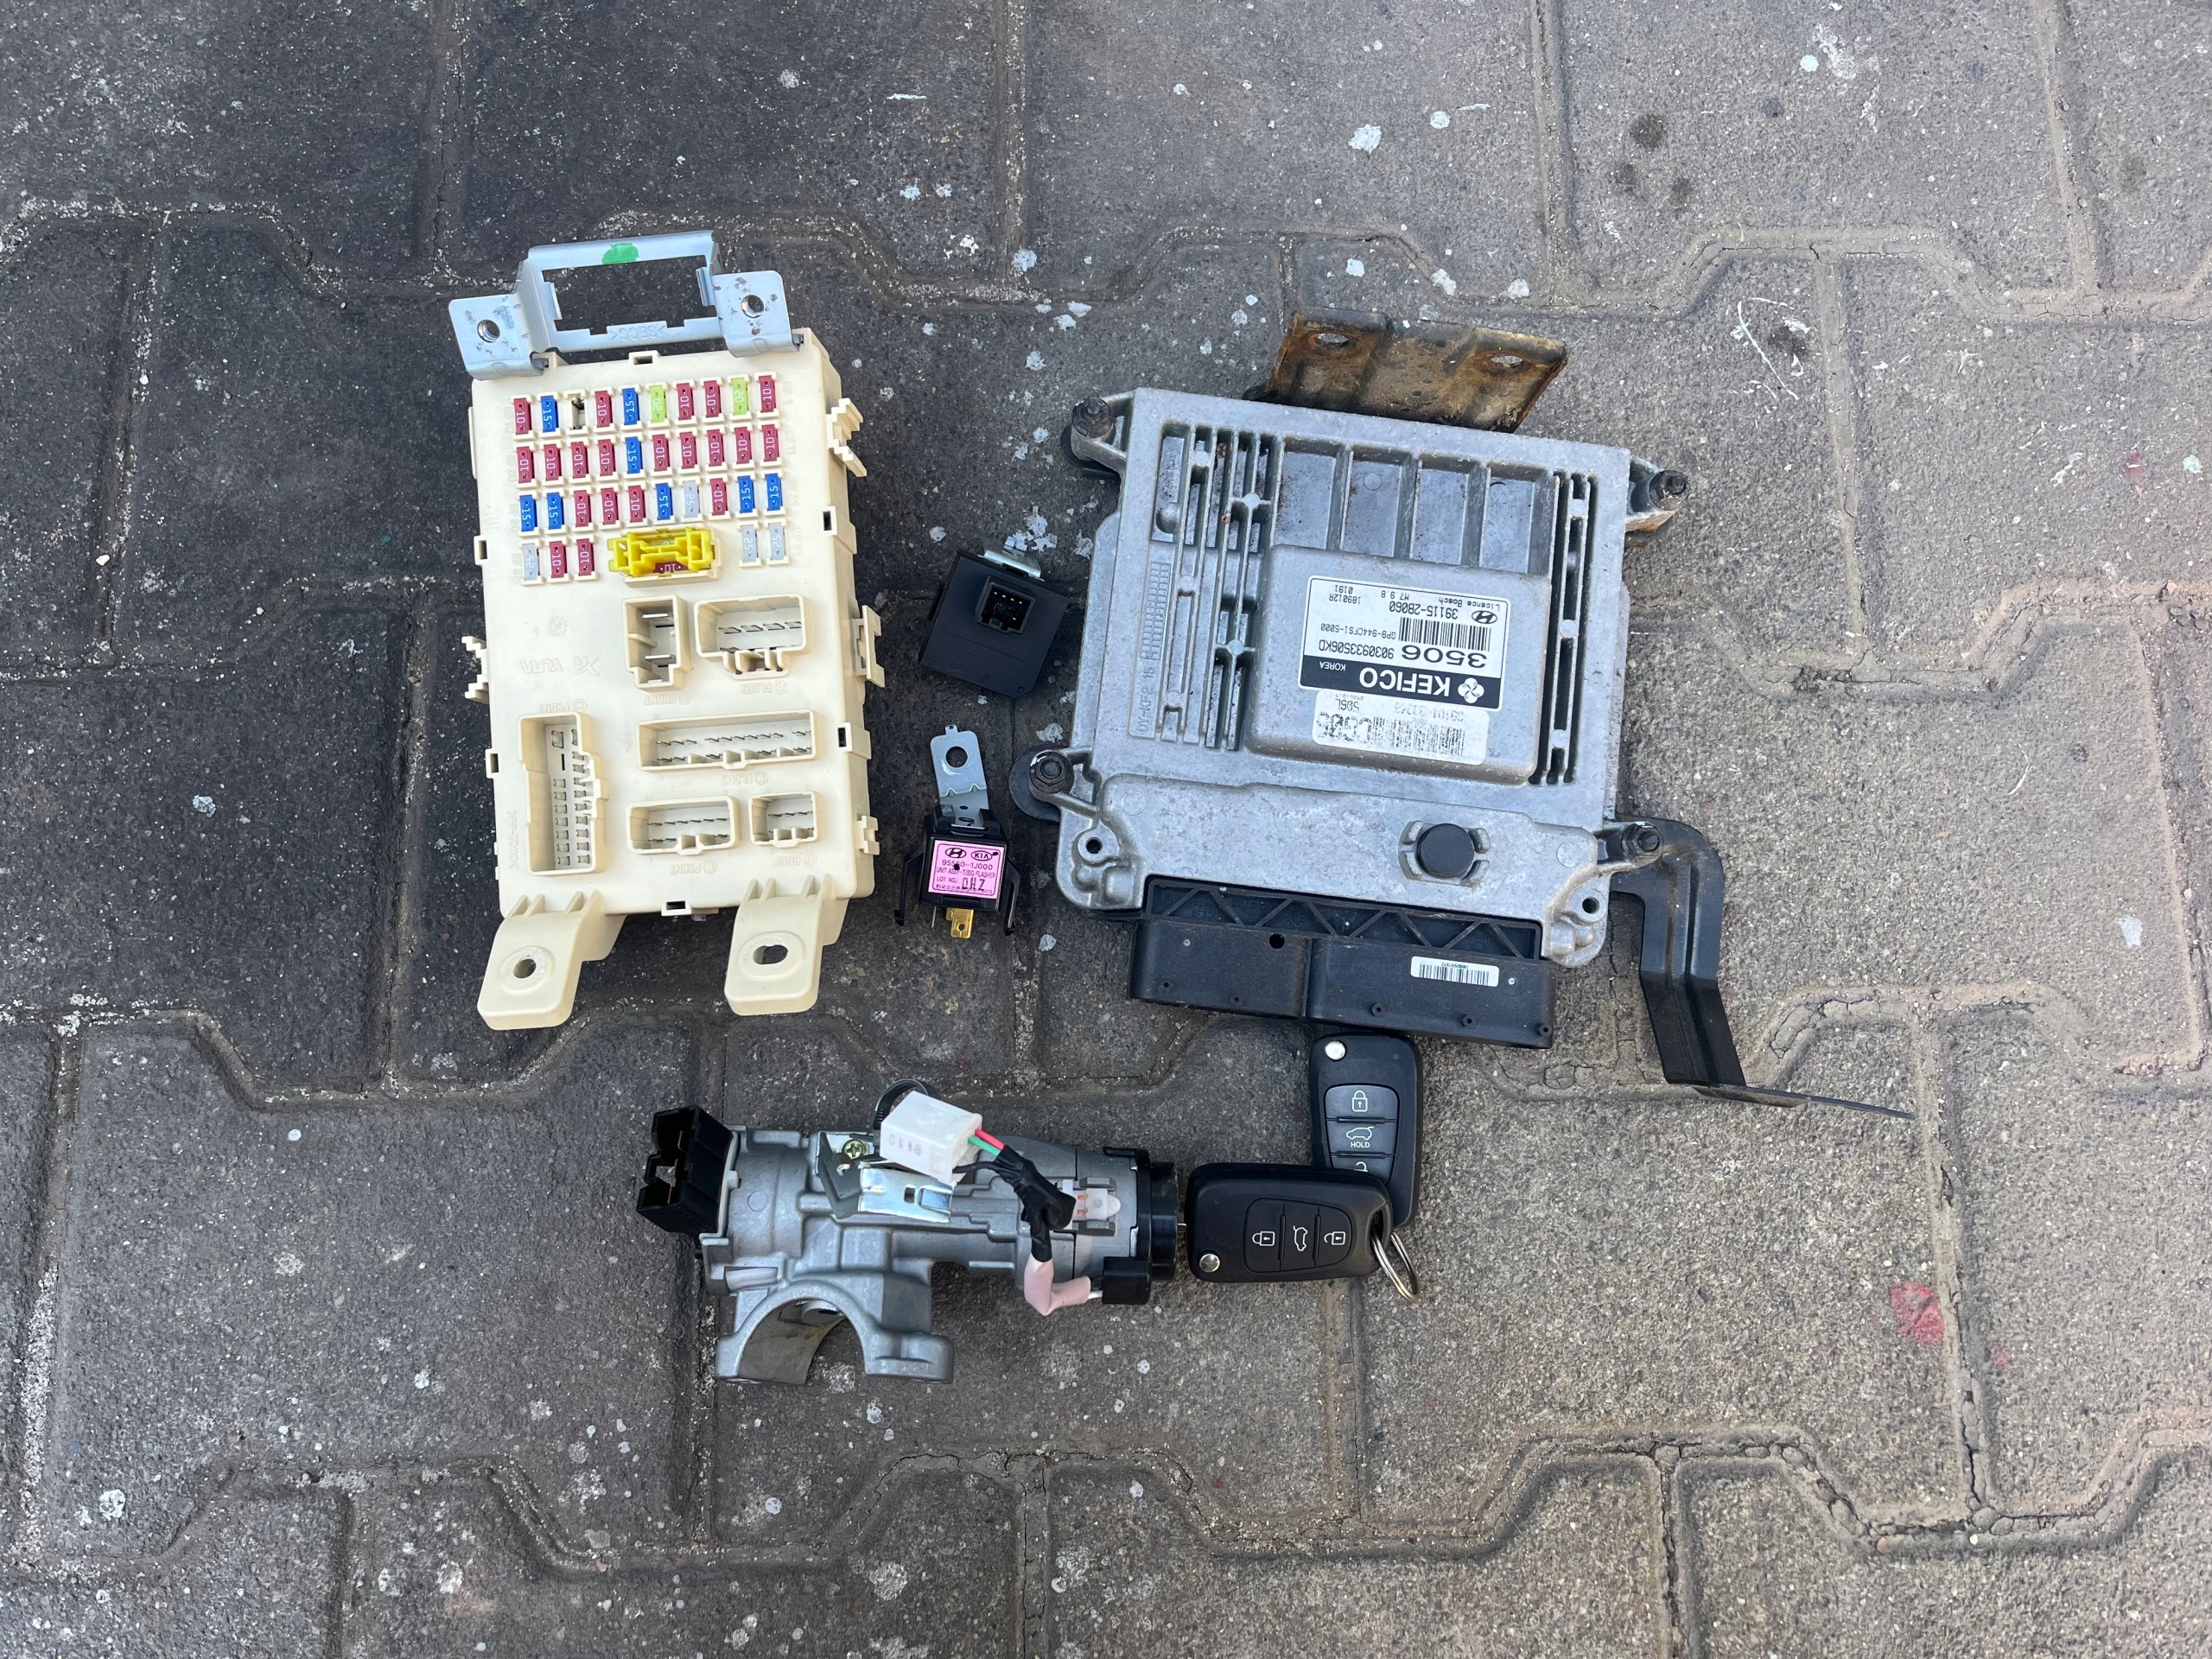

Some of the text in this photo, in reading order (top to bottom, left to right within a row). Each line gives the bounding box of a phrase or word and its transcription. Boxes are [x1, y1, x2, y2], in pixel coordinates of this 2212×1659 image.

[707, 394, 716, 406] 10
[735, 390, 744, 403] 20
[762, 388, 772, 401] 10
[625, 400, 635, 413] 15
[653, 398, 662, 411] 20
[680, 396, 690, 408] 10
[543, 408, 553, 422] 15
[597, 404, 607, 417] 10
[516, 412, 526, 424] 10
[711, 442, 720, 455] 10
[738, 440, 747, 452] 10
[766, 437, 775, 449] 10
[628, 450, 637, 462] 15
[656, 448, 665, 460] 10
[683, 445, 692, 457] 10
[546, 457, 556, 470] 10
[574, 454, 583, 466] 10
[601, 453, 610, 465] 10
[520, 459, 529, 472] 10
[714, 491, 723, 503] 10
[741, 488, 751, 501] 15
[769, 485, 779, 498] 15
[631, 498, 640, 511] 10
[659, 496, 669, 508] 15
[685, 493, 695, 506] 25
[549, 506, 559, 518] 15
[577, 503, 587, 515] 10
[604, 500, 614, 513] 10
[522, 508, 531, 520] 15
[744, 537, 754, 550] 25
[772, 535, 782, 548] 25
[525, 555, 535, 568] 25
[552, 554, 562, 567] 10
[580, 551, 589, 564] 10
[1335, 585, 1353, 594] 0191
[1329, 593, 1361, 604] 189012R
[1439, 597, 1462, 608] Bosch
[1389, 601, 1458, 619] 39115-2B060
[1467, 600, 1499, 611] Licence
[1319, 640, 1394, 659] 9030933506KD
[1402, 645, 1487, 668] 3506
[1320, 661, 1346, 671] KOREA
[1359, 667, 1450, 696] KEFICO
[741, 683, 772, 694] FLOOR
[644, 692, 676, 705] FRONT
[722, 773, 753, 785] FLOOR
[773, 855, 801, 867] ROOF
[669, 863, 701, 875] FRONT
